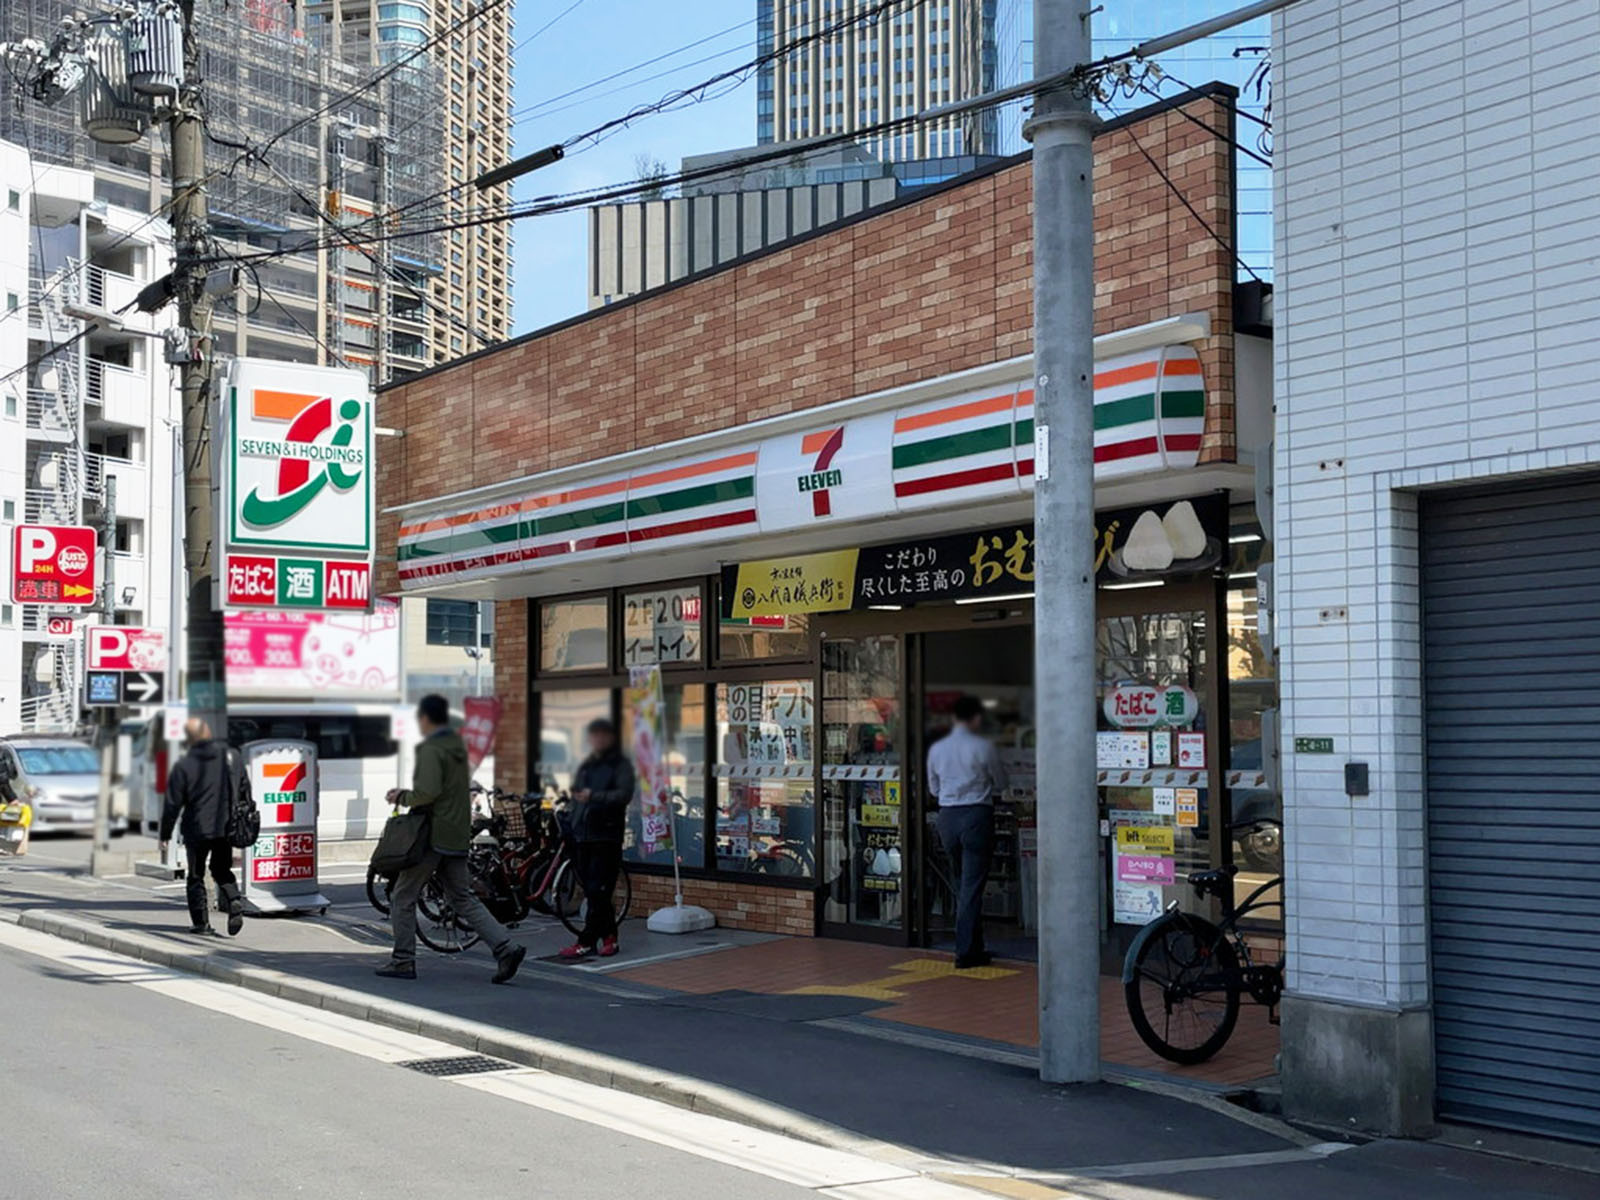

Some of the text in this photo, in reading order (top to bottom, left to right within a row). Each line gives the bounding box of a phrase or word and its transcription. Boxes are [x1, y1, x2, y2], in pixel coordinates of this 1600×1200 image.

[300, 444, 364, 464] HOLDINGS
[20, 528, 57, 573] P
[884, 547, 937, 570] こだわり
[969, 520, 1120, 587] おむび
[35, 564, 54, 573] 24H
[230, 564, 274, 595] たばこ
[287, 567, 315, 598] 酒
[861, 568, 965, 598] 尽くした至高の
[328, 569, 368, 600] ATM
[92, 630, 127, 667] P
[626, 633, 700, 662] イートイン
[1115, 692, 1157, 716] たばこ
[1165, 691, 1185, 715] 酒
[254, 836, 313, 857] 酒 たばこ
